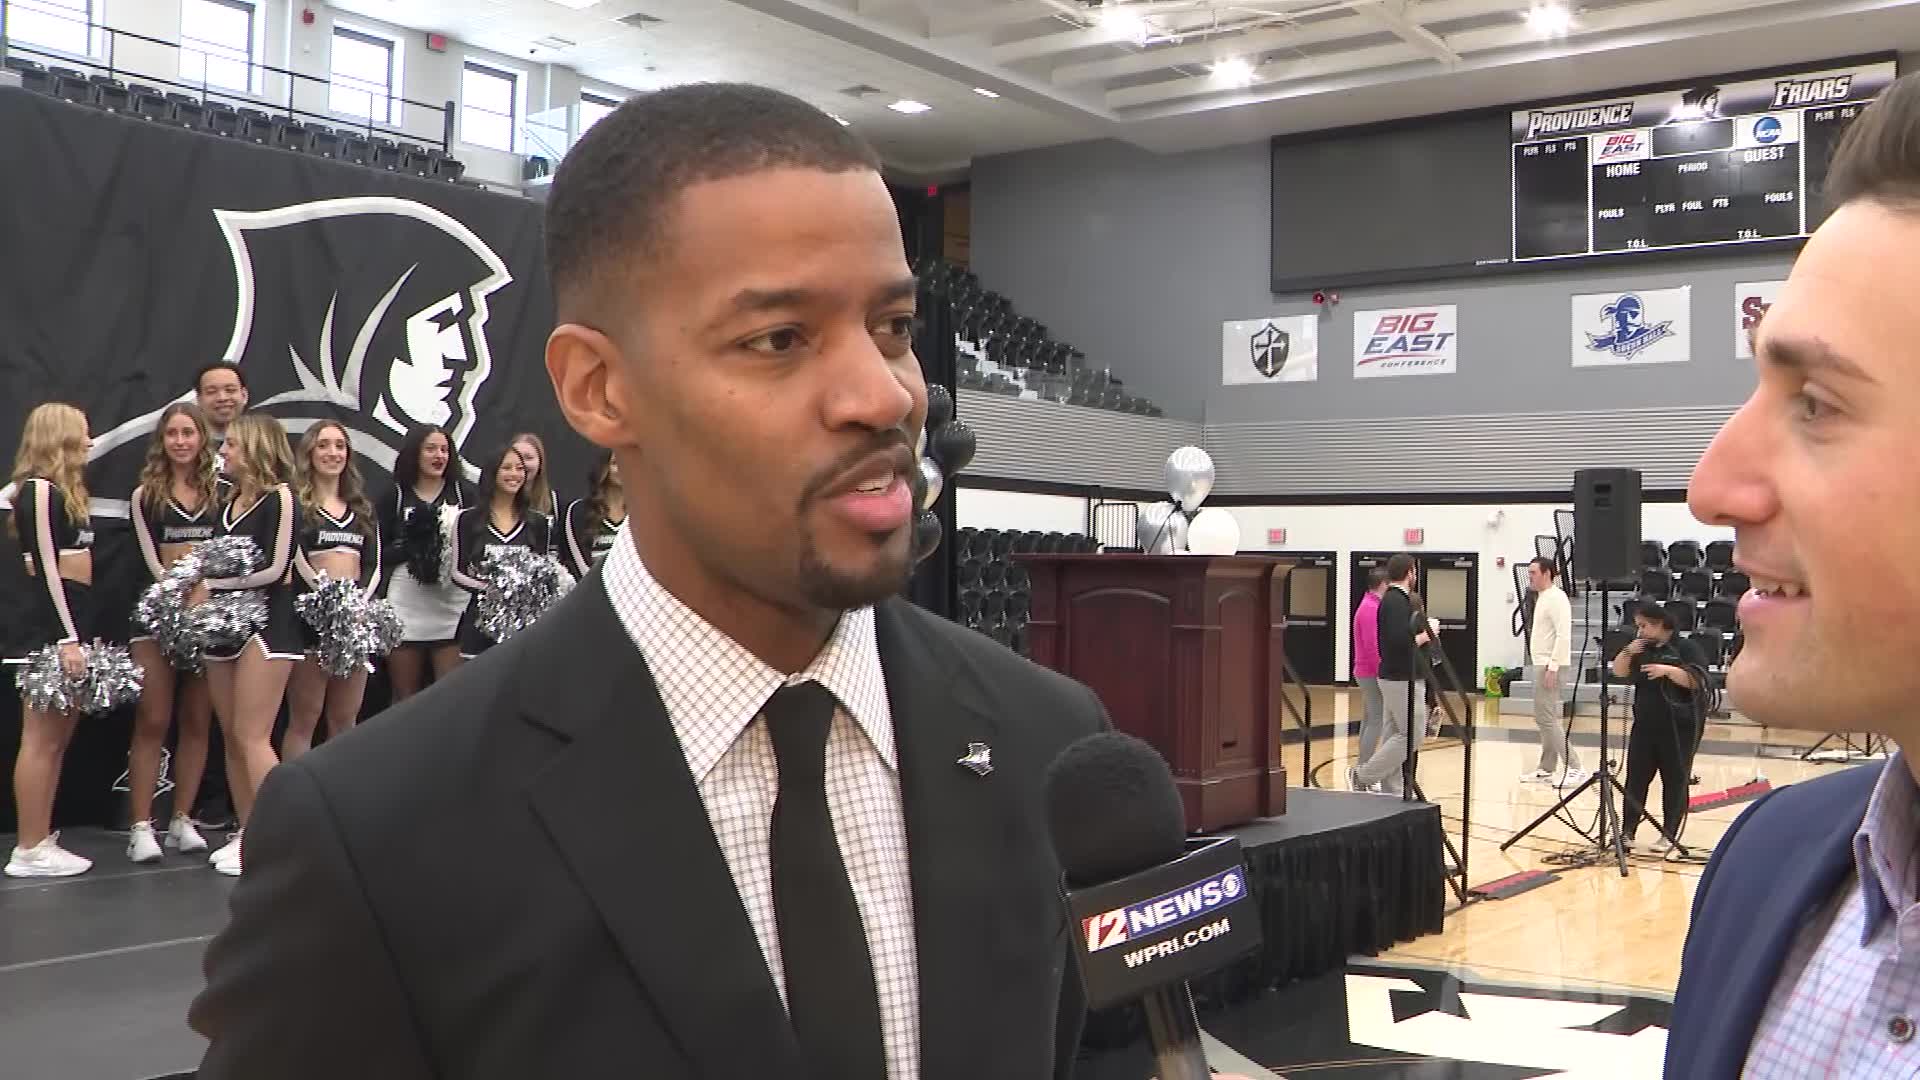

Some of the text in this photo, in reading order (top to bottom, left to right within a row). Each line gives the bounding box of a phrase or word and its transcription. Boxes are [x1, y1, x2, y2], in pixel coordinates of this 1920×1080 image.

[1525, 76, 1853, 140] PROVIDENCE FRIARS
[1606, 134, 1636, 145] BIG
[1601, 142, 1644, 155] EAST
[1744, 147, 1785, 163] GUEST
[1606, 163, 1641, 178] HOME
[1682, 201, 1704, 212] FOUL
[1712, 198, 1729, 209] PTS
[1764, 191, 1794, 204] FOULS
[1598, 208, 1625, 220] FOULS
[1374, 312, 1439, 335] BIG
[1363, 332, 1455, 356] EAST
[1087, 879, 1223, 952] 12 NEWS
[1123, 918, 1231, 968] WPRI.COM
